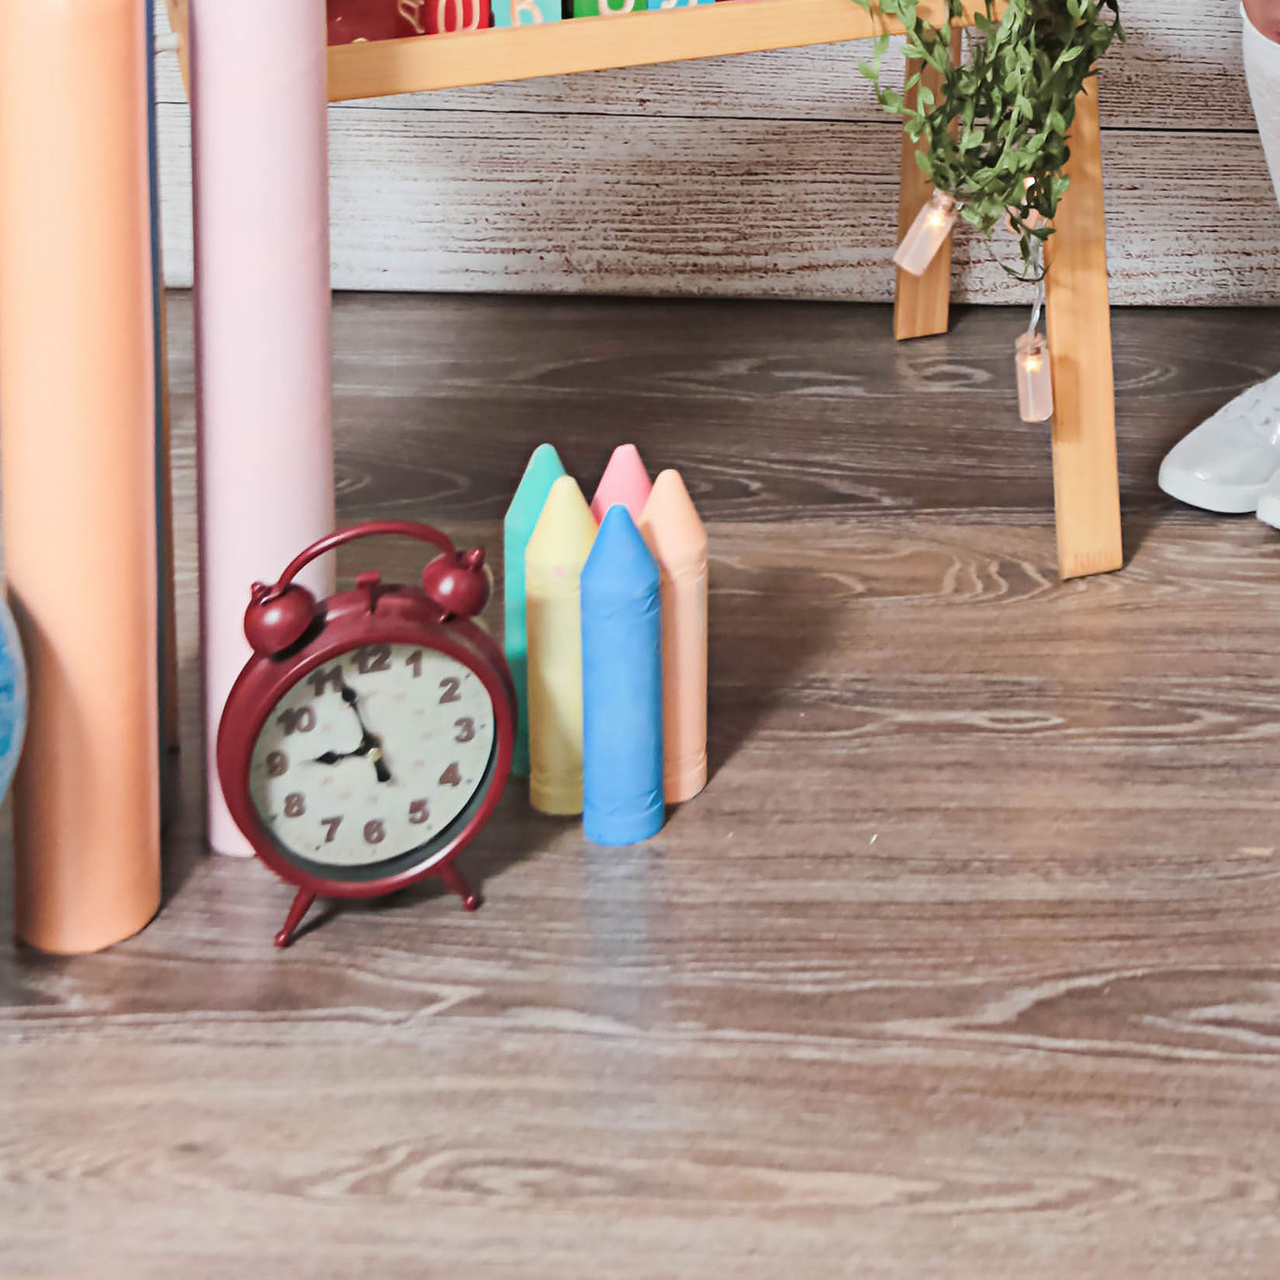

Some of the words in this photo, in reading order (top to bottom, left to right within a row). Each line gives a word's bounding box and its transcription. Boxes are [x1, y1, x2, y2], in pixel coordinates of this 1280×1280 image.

[352, 646, 393, 674] 12
[404, 650, 424, 678] 1
[306, 664, 344, 696] 11
[438, 677, 462, 704] 2
[277, 706, 316, 736] 10
[453, 717, 476, 743] 3
[266, 751, 289, 778] 9
[438, 762, 462, 787] 4
[284, 793, 306, 818] 8
[408, 799, 430, 825] 5
[321, 816, 344, 843] 7
[363, 819, 386, 845] 6
